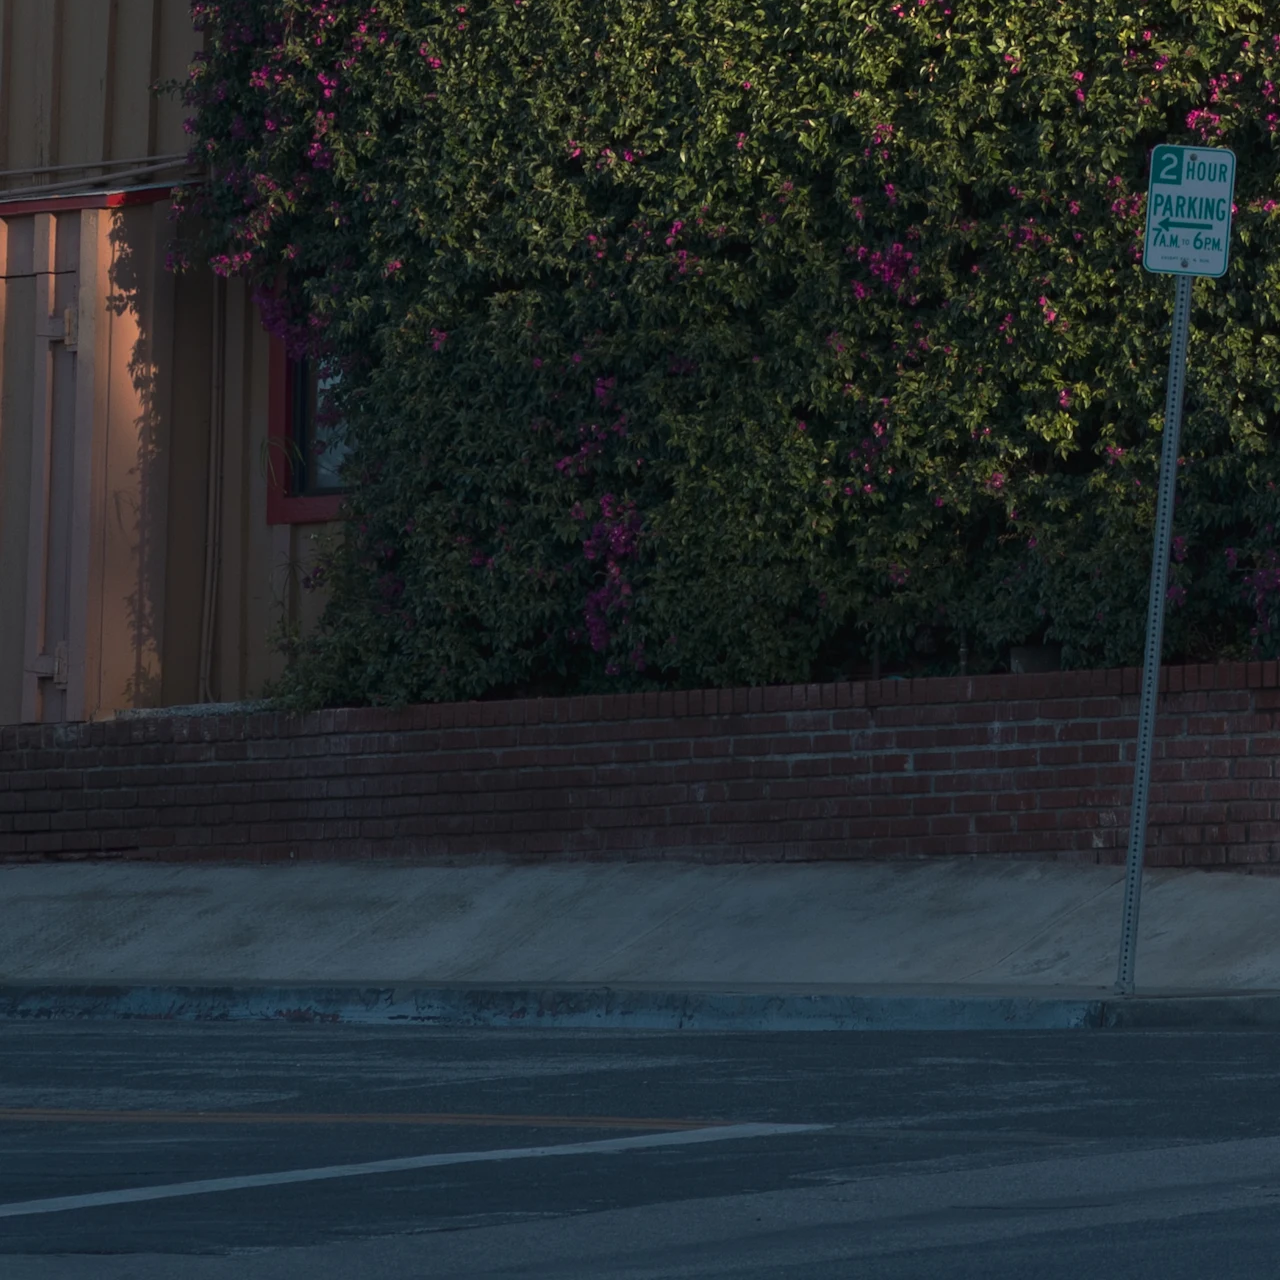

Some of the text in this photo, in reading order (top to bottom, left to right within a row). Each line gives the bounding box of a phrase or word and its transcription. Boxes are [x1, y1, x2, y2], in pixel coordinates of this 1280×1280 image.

[1160, 153, 1228, 183] 2 HOUR
[1153, 193, 1226, 222] PARKING
[1182, 238, 1190, 246] TO
